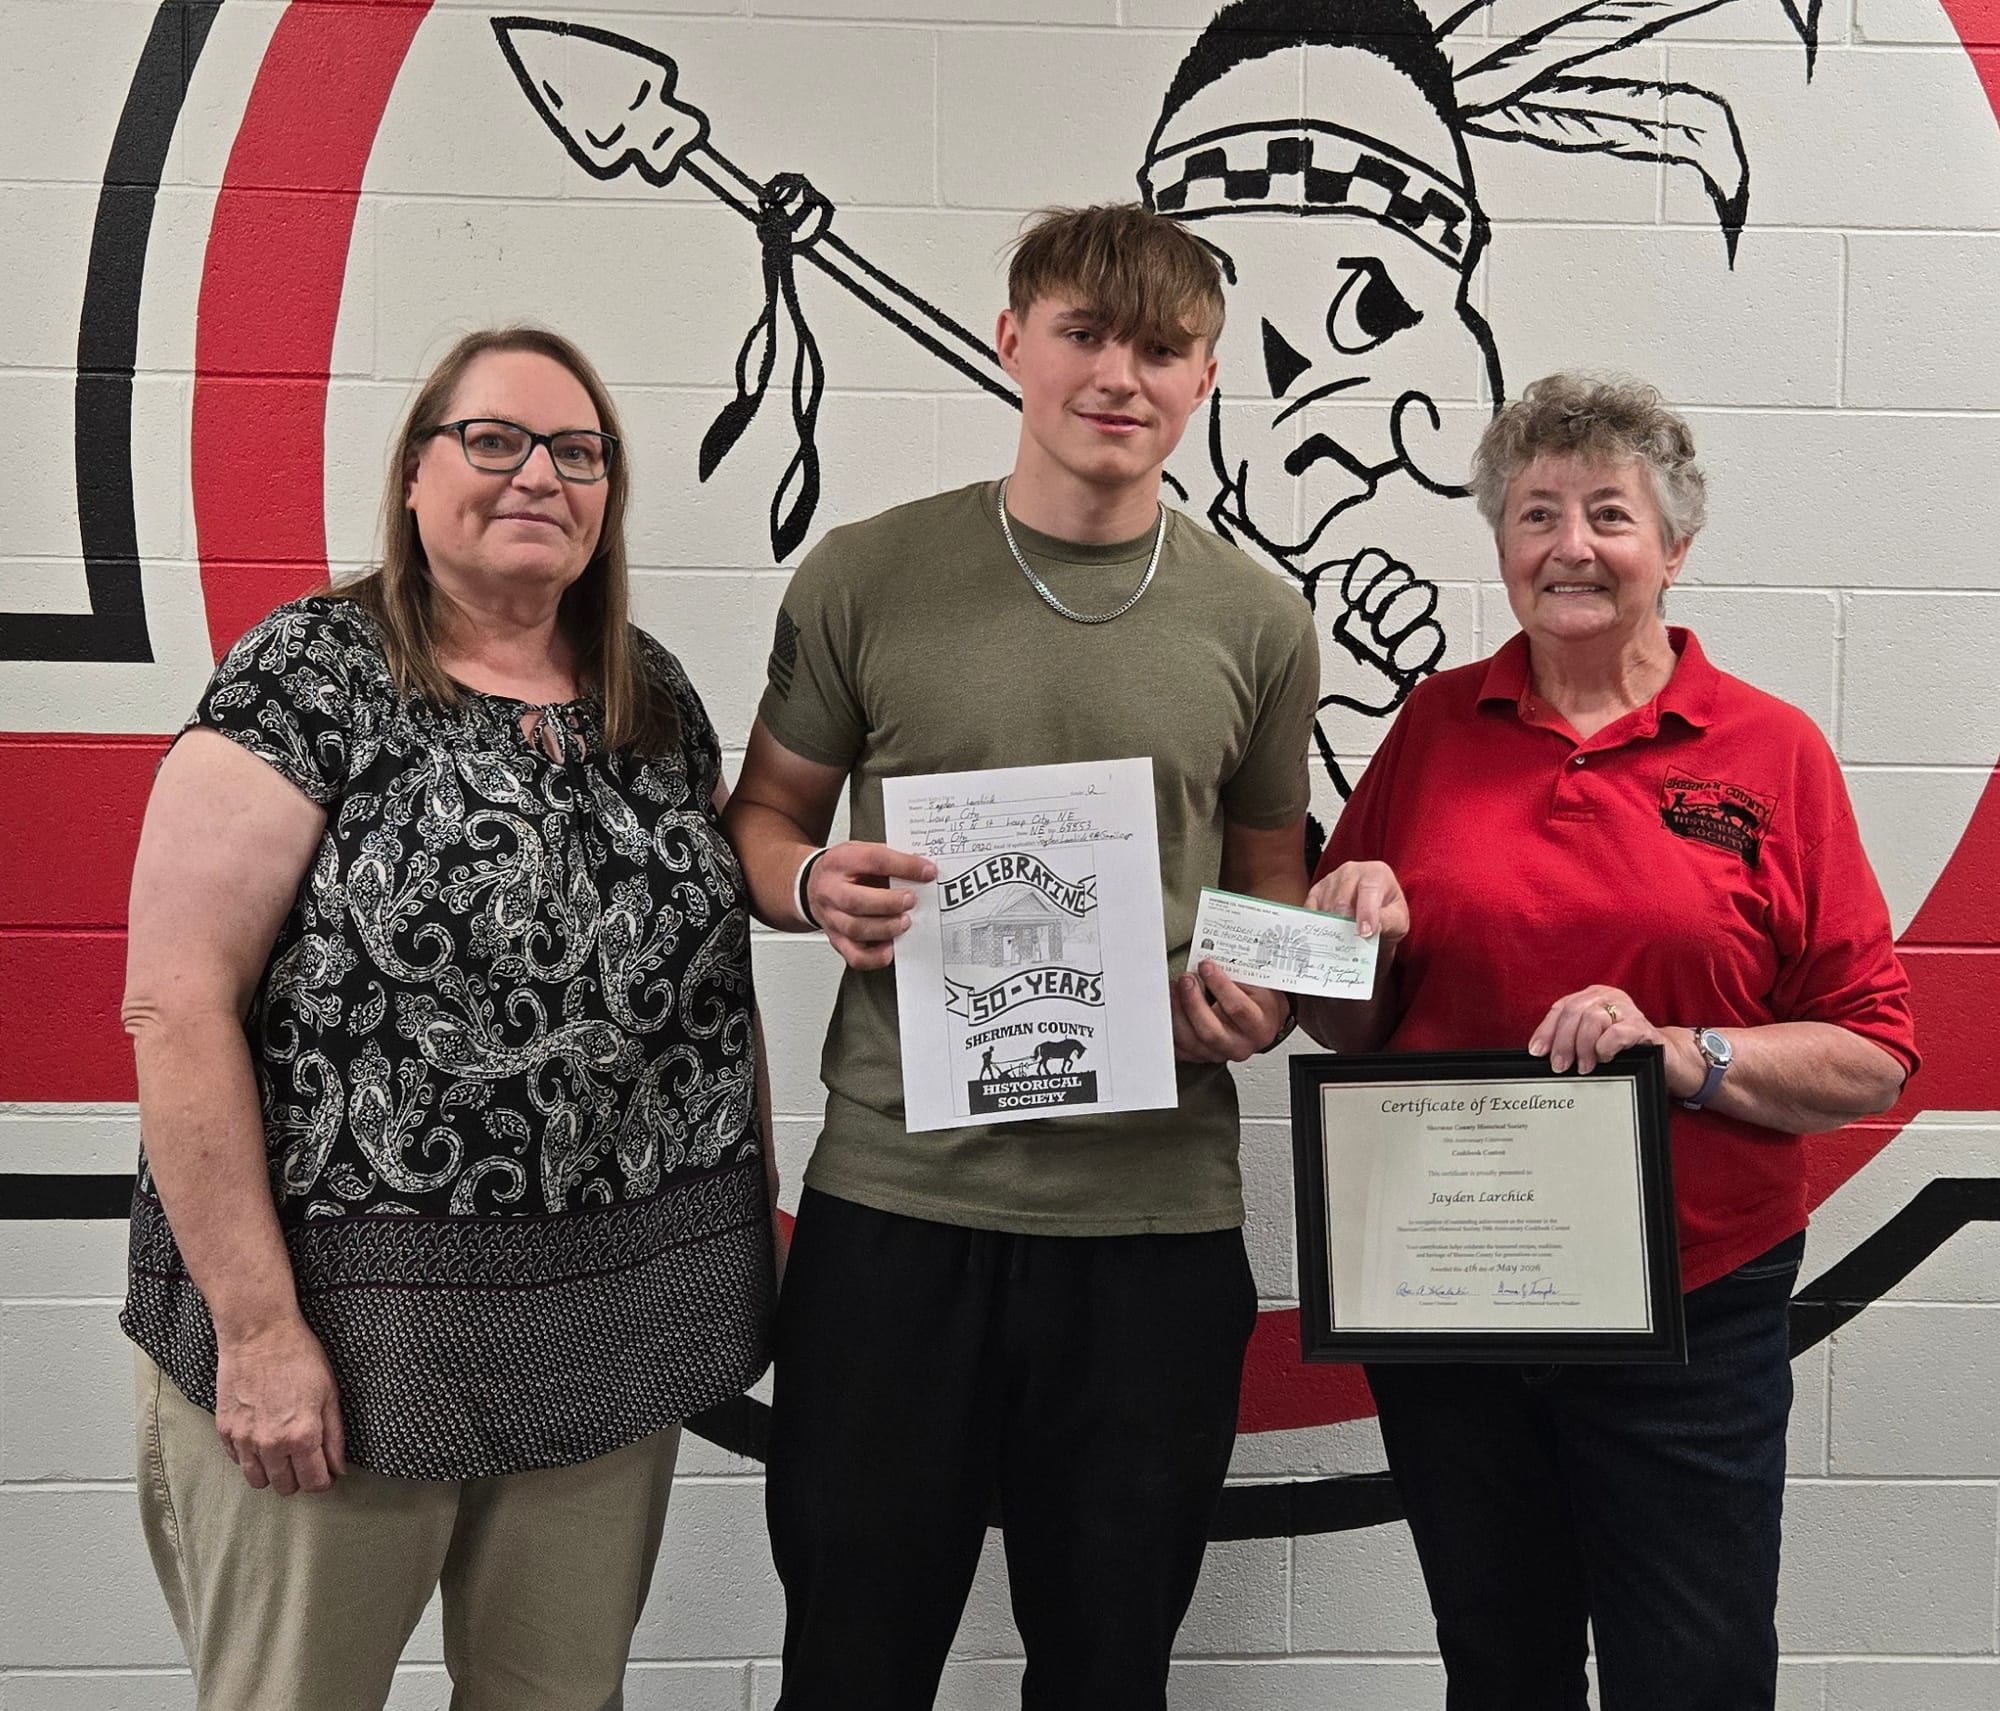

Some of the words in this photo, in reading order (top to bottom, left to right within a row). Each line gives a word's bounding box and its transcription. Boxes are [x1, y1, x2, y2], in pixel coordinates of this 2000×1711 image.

[1665, 778, 1721, 791] SHERMAN
[1725, 787, 1770, 818] COUNTY
[1031, 814, 1050, 826] City
[1056, 811, 1075, 822] NE
[1030, 825, 1046, 836] NE
[1687, 826, 1744, 849] SOCIETY
[944, 856, 1086, 913] CELEBRATING
[965, 1022, 1034, 1050] SHERMAN
[1037, 1022, 1095, 1038] COUNTY
[982, 1077, 1082, 1096] HISTORICAL
[998, 1091, 1067, 1108] SOCIETY
[1381, 1097, 1465, 1117] Certificate
[1470, 1096, 1486, 1115] of
[1489, 1094, 1575, 1111] Excellence
[1454, 1124, 1476, 1132] County
[1507, 1123, 1528, 1131] Society
[1429, 1190, 1475, 1207] Jayden
[1478, 1189, 1535, 1204] Larchick
[1463, 1263, 1477, 1272] 4th
[1495, 1263, 1518, 1274] May
[1519, 1264, 1541, 1272] 2026
